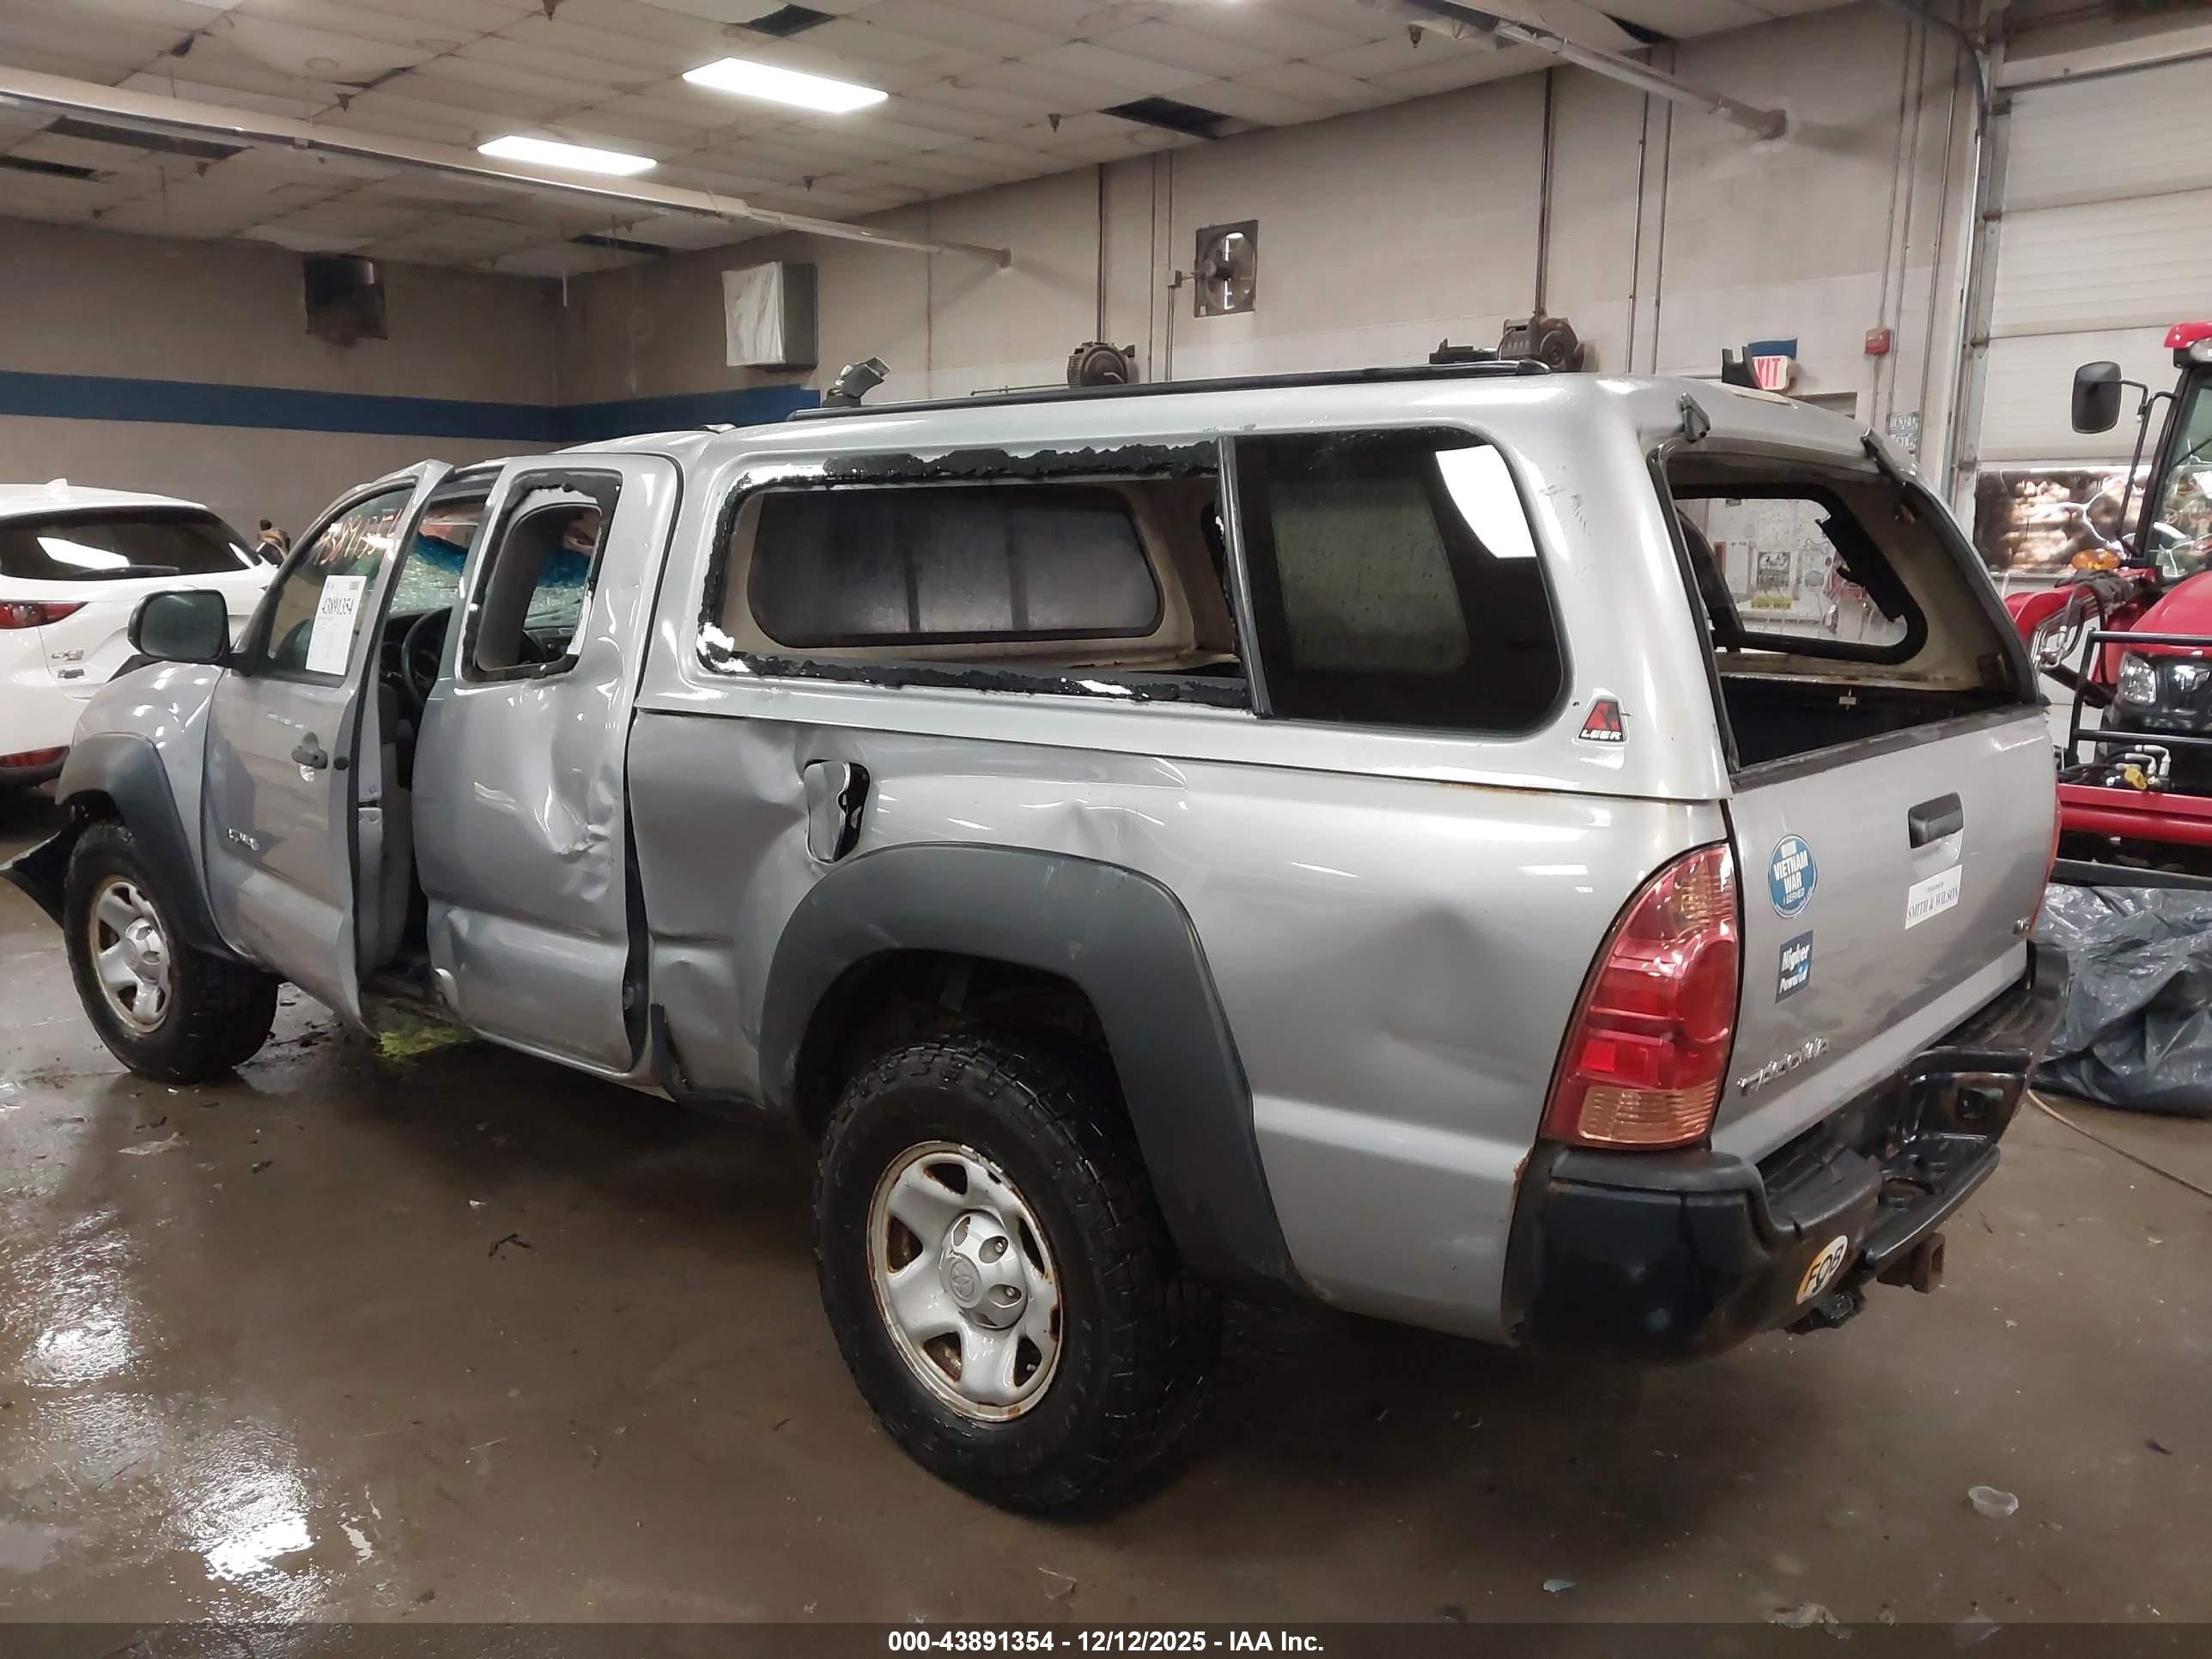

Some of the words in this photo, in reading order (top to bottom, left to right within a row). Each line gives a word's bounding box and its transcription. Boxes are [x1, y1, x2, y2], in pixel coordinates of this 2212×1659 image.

[1753, 357, 1781, 386] XIT
[321, 597, 356, 616] 43891354
[1581, 729, 1622, 740] LEER
[1773, 850, 1808, 881] VIETNAM
[1784, 871, 1802, 895] WAR
[1786, 887, 1805, 904] SERVED
[1908, 898, 1929, 919] SMITH
[1936, 886, 1959, 907] WILSON
[1781, 943, 1811, 972] Higher
